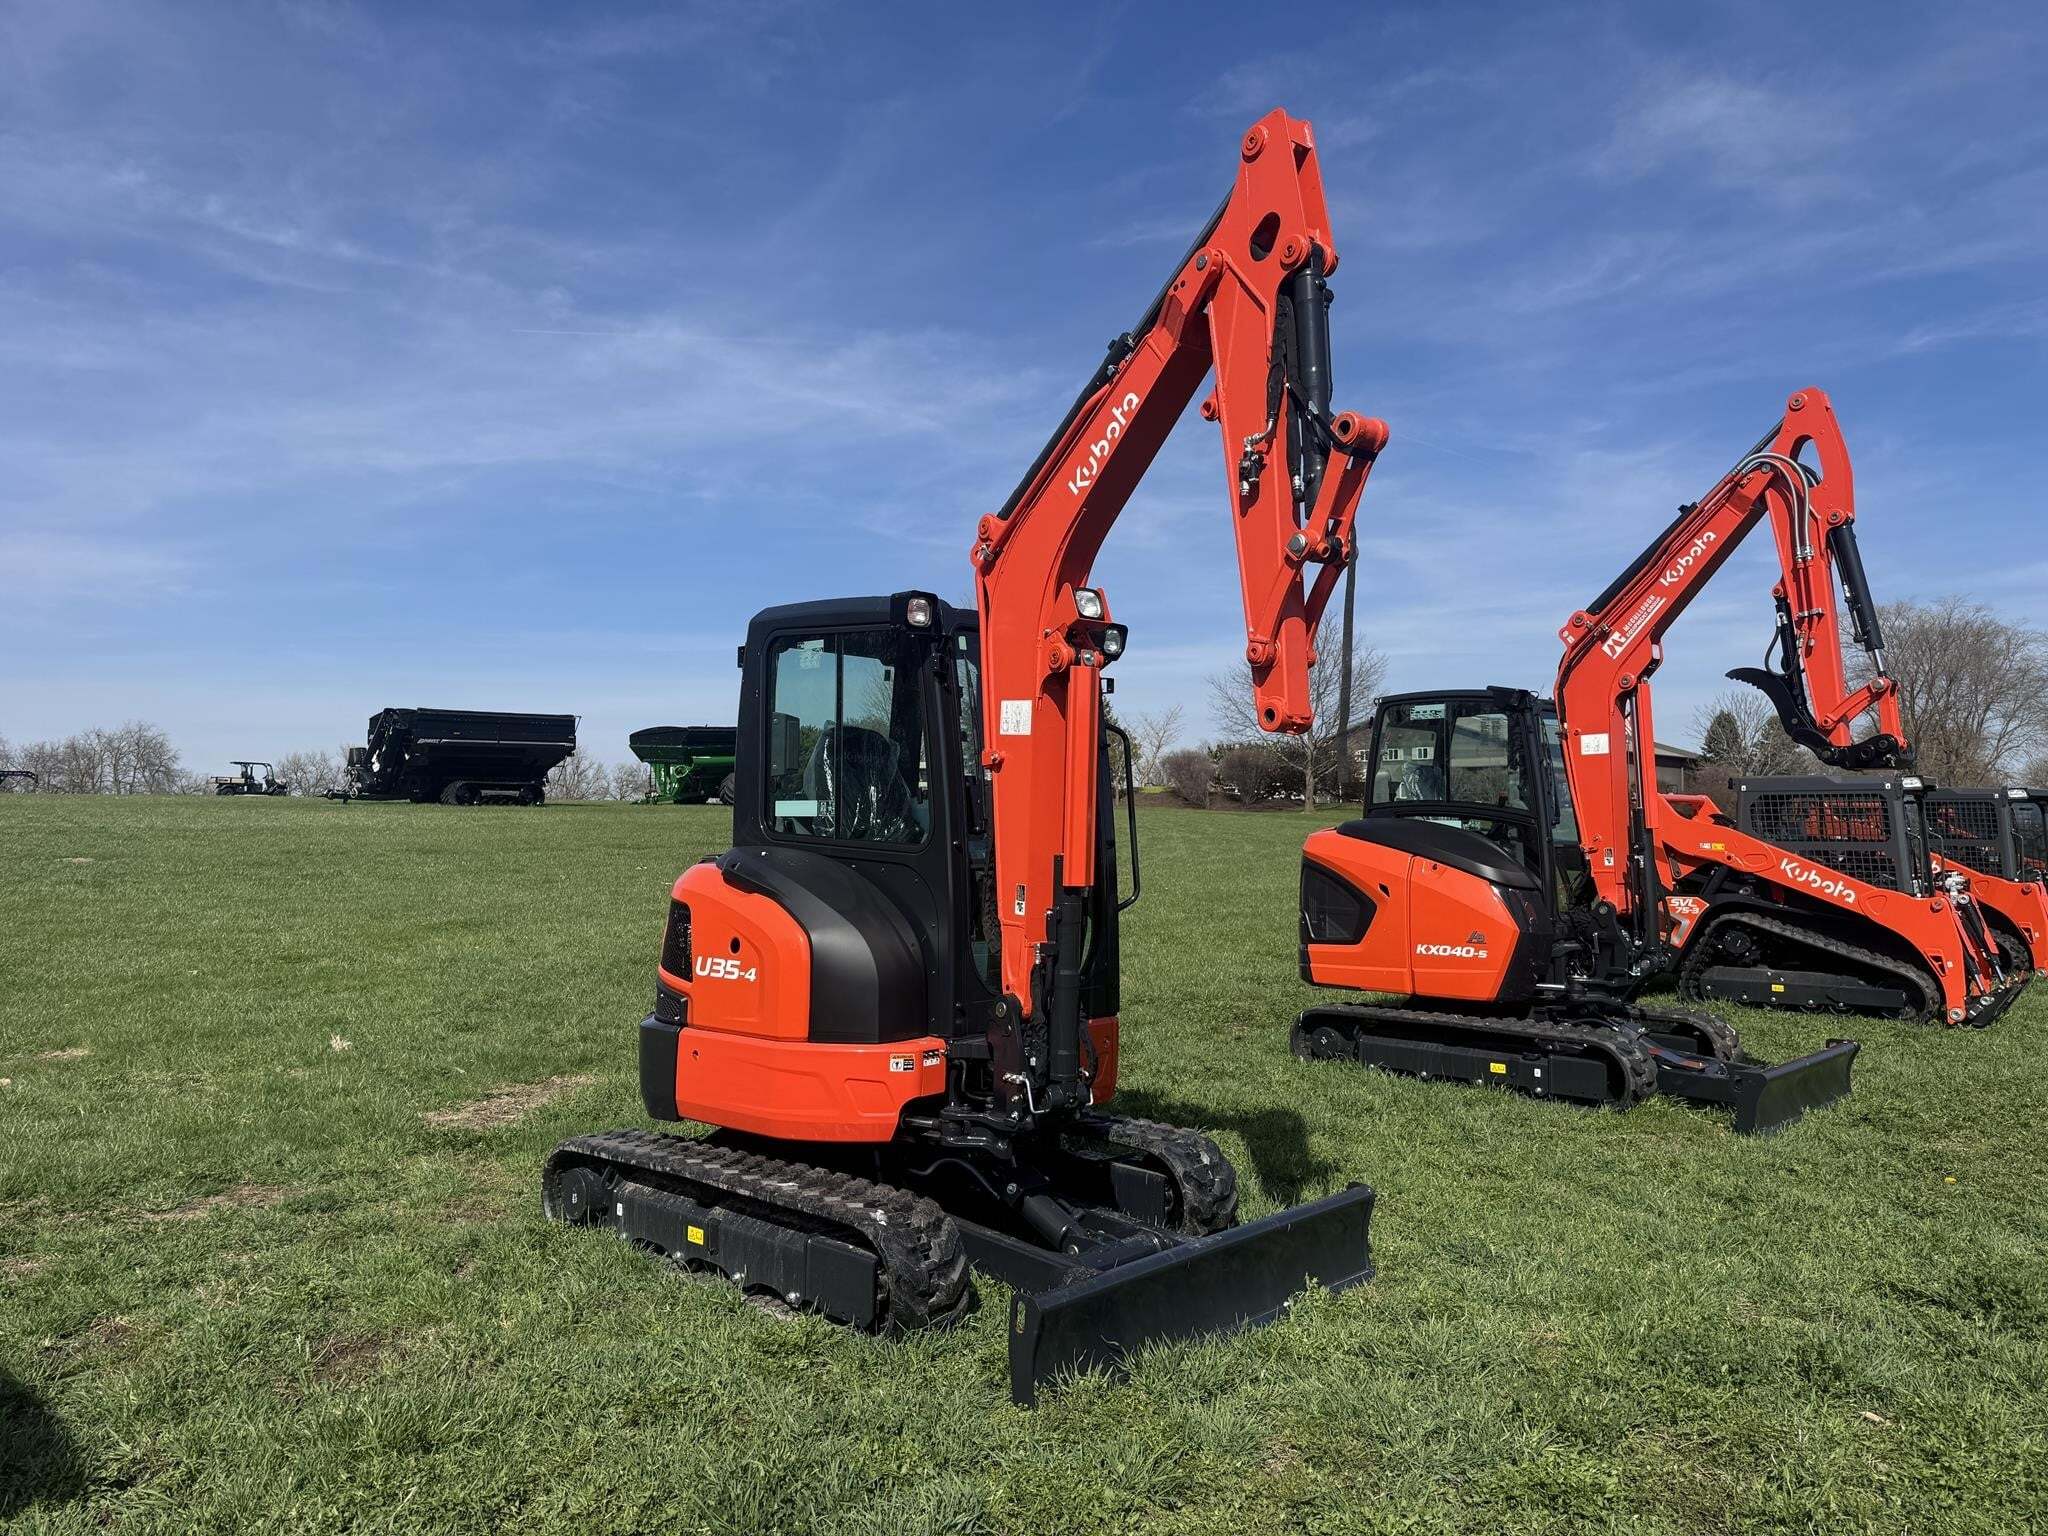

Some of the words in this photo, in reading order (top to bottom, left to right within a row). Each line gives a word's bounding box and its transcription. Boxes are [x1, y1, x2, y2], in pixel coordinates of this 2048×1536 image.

[1067, 392, 1140, 496] Kubota
[1659, 531, 1717, 586] Kubota
[1670, 898, 1697, 907] SVL
[1780, 857, 1857, 905] Kubota
[695, 956, 758, 983] U35-4
